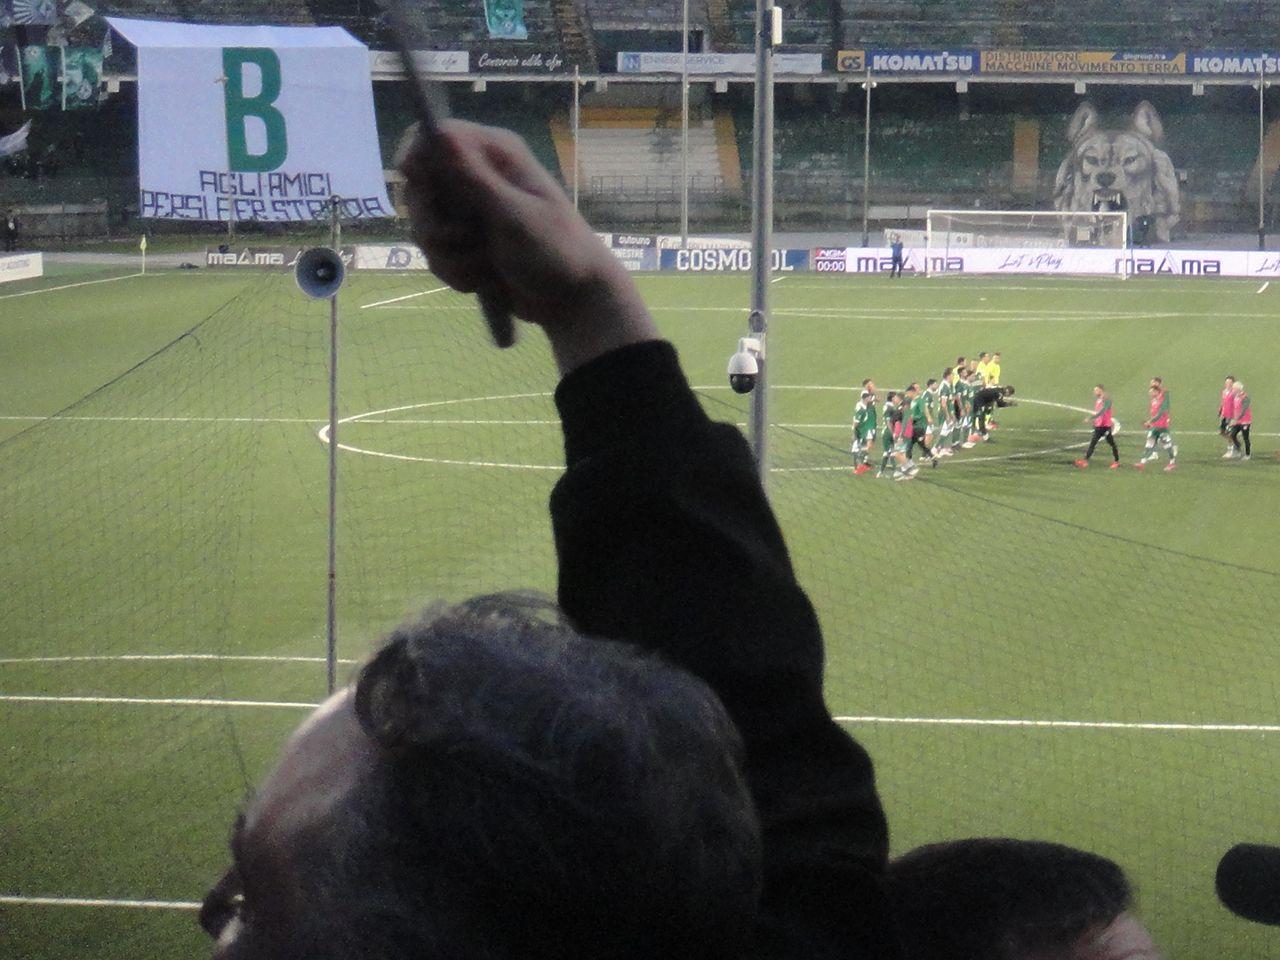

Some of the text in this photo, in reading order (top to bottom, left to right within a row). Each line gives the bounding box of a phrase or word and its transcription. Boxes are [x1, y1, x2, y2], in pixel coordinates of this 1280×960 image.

[873, 51, 973, 72] KOMATSU
[985, 62, 1180, 72] MACCHINE MOVIMENTO TERRA
[222, 46, 288, 173] B
[200, 170, 332, 198] AGLI AMICI
[141, 190, 209, 220] PERSI
[271, 196, 386, 221] STRDA
[677, 248, 794, 271] COSMOOL
[816, 259, 846, 272] 00:00
[1035, 252, 1064, 270] Play
